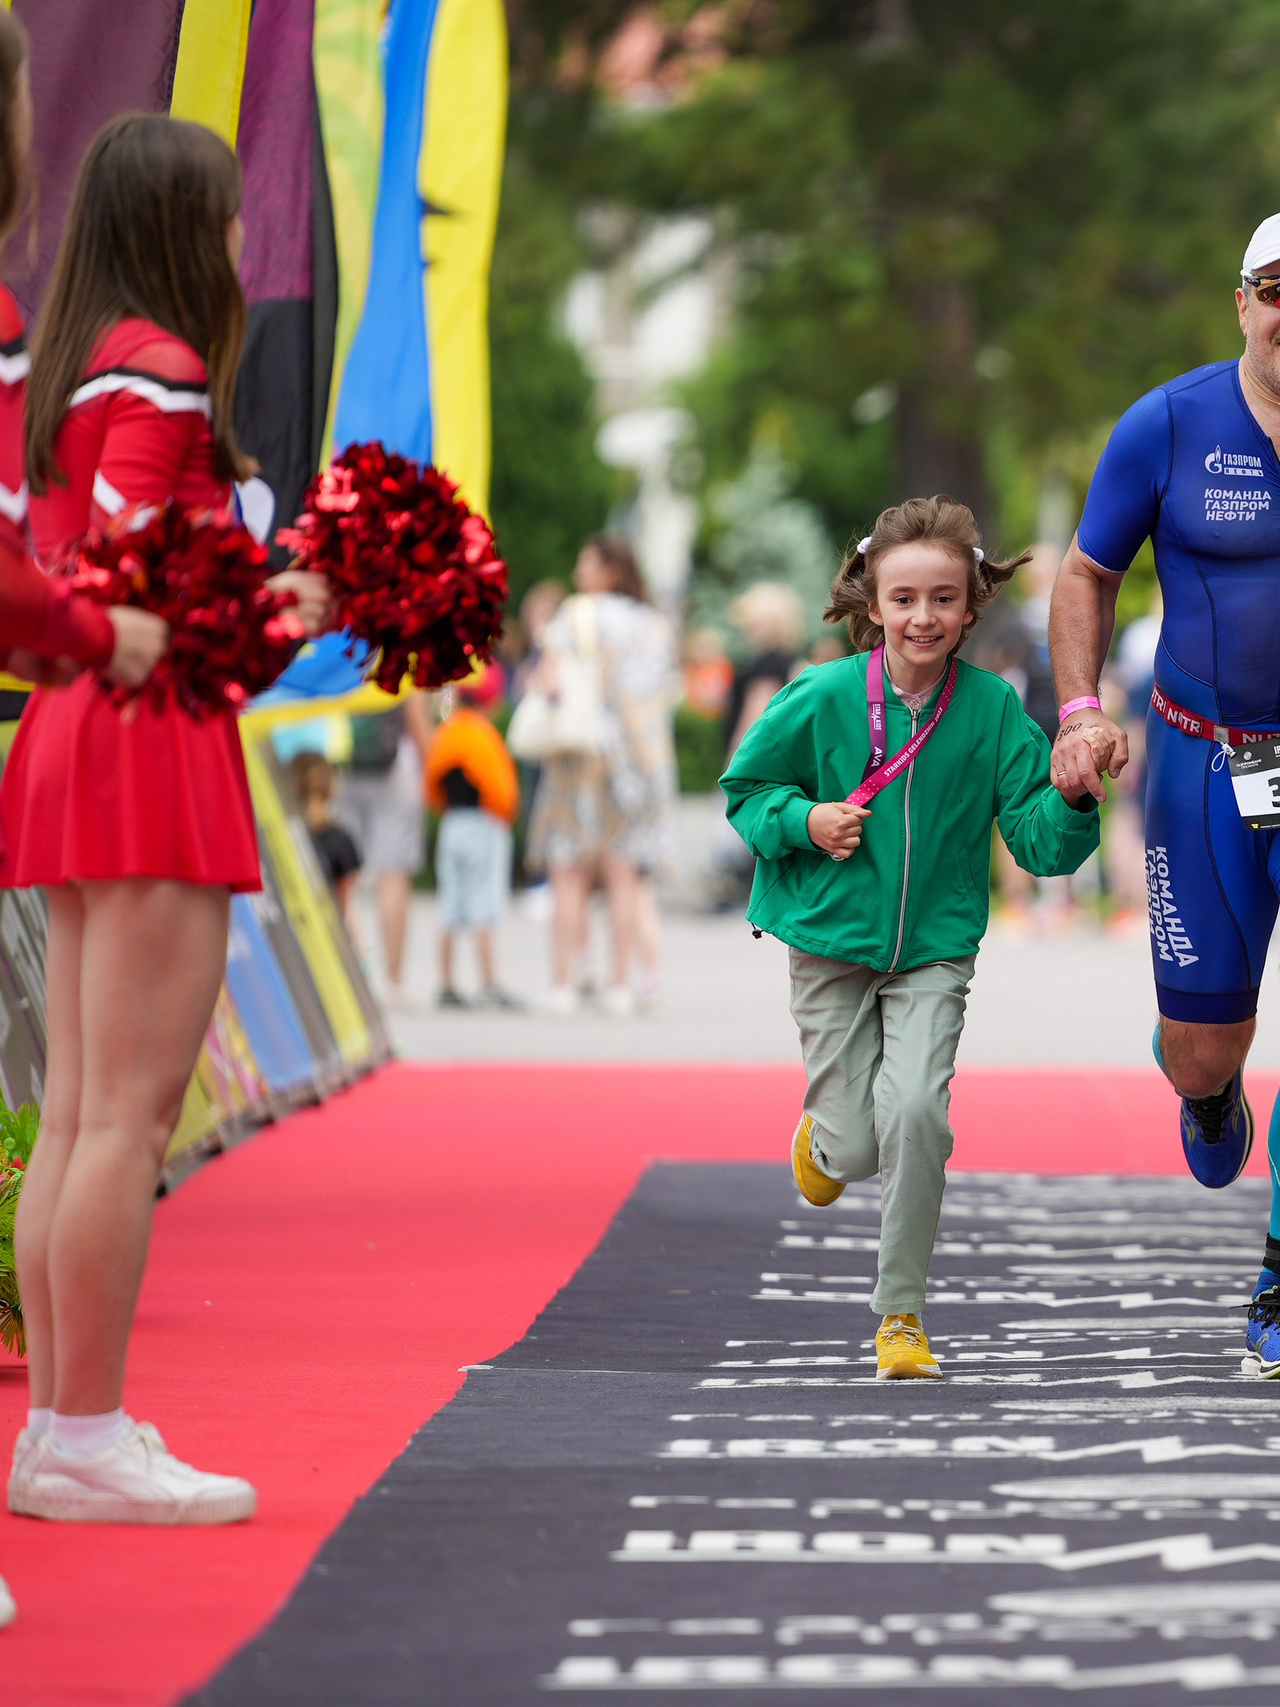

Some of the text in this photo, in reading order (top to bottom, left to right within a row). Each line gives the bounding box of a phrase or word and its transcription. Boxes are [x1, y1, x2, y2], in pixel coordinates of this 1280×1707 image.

[1223, 453, 1262, 468] ГАЗПРОМ
[1204, 488, 1272, 500] КОМАНДА
[1205, 499, 1270, 511] ГАЗПРОМ
[1205, 510, 1256, 521] НЕФТИ
[1057, 722, 1083, 742] 300
[884, 751, 910, 777] STARKIDS
[1147, 848, 1173, 962] ГАЗПРОМ
[1156, 845, 1200, 968] КОМАНДА
[710, 1350, 1043, 1366] IRN
[668, 1436, 1055, 1455] IRON
[622, 1530, 1068, 1557] IRON
